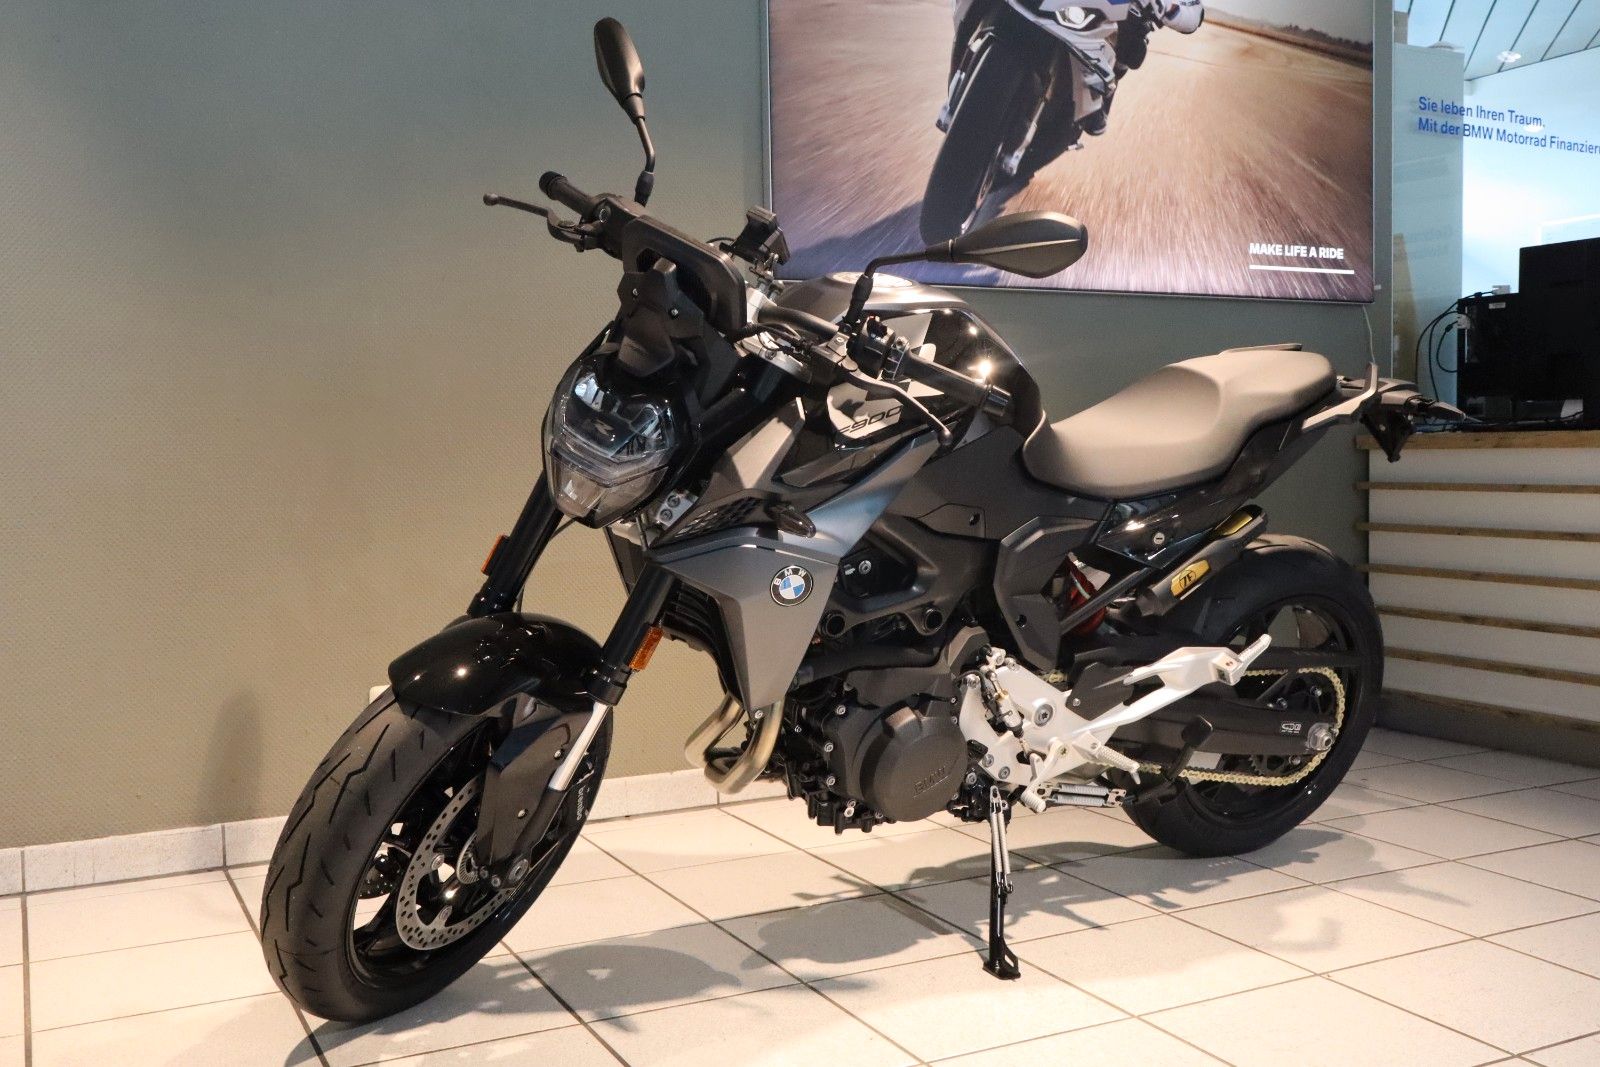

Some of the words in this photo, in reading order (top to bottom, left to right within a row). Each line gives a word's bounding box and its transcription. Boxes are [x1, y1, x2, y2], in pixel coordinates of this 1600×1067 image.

[1418, 96, 1438, 112] Sie
[1441, 100, 1473, 117] leben
[1476, 105, 1505, 122] Ihren
[1508, 110, 1546, 127] Traum.
[1418, 117, 1438, 133] Mit
[1441, 122, 1460, 136] der
[1463, 124, 1494, 141] BMW
[1496, 128, 1547, 148] Motorrad
[1248, 243, 1283, 256] MAKE
[1284, 245, 1308, 258] LIFE
[1308, 246, 1318, 258] A
[1319, 247, 1345, 260] RIDE
[773, 567, 808, 586] BMW
